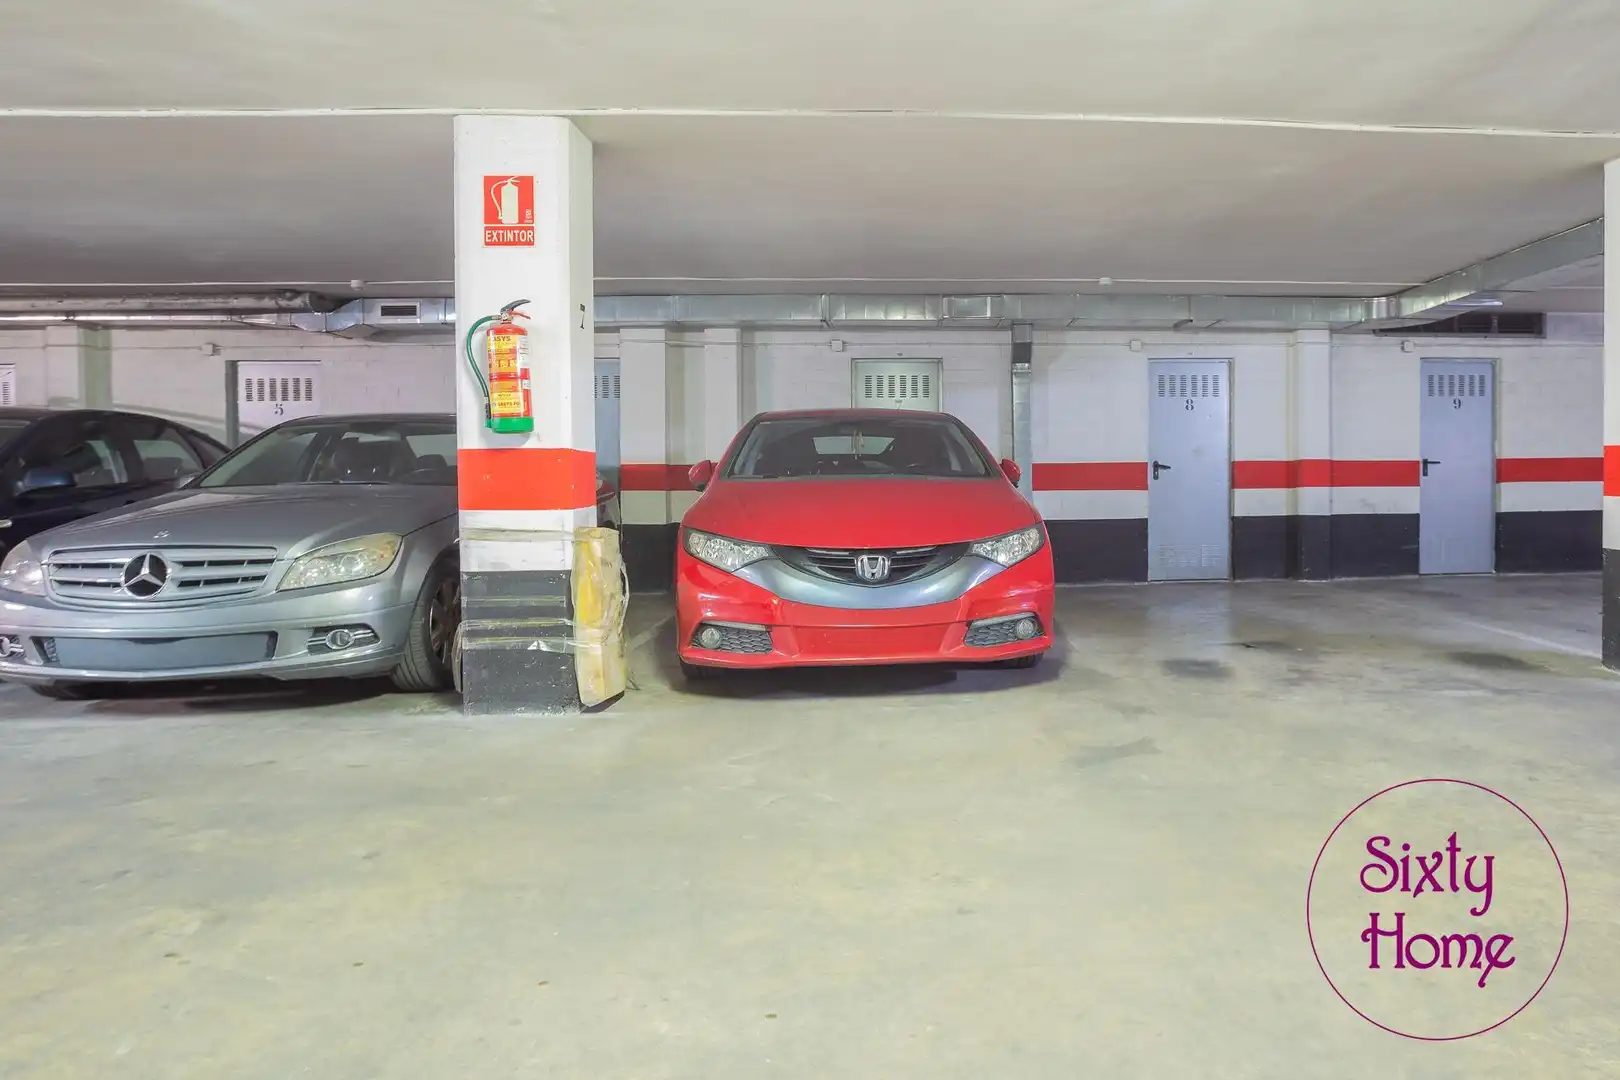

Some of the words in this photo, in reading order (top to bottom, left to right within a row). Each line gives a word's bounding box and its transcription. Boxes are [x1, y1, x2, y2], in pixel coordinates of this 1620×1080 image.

[485, 230, 534, 243] EXTINTOR
[273, 403, 284, 415] 5
[1185, 399, 1195, 411] 8
[1453, 399, 1462, 410] 9
